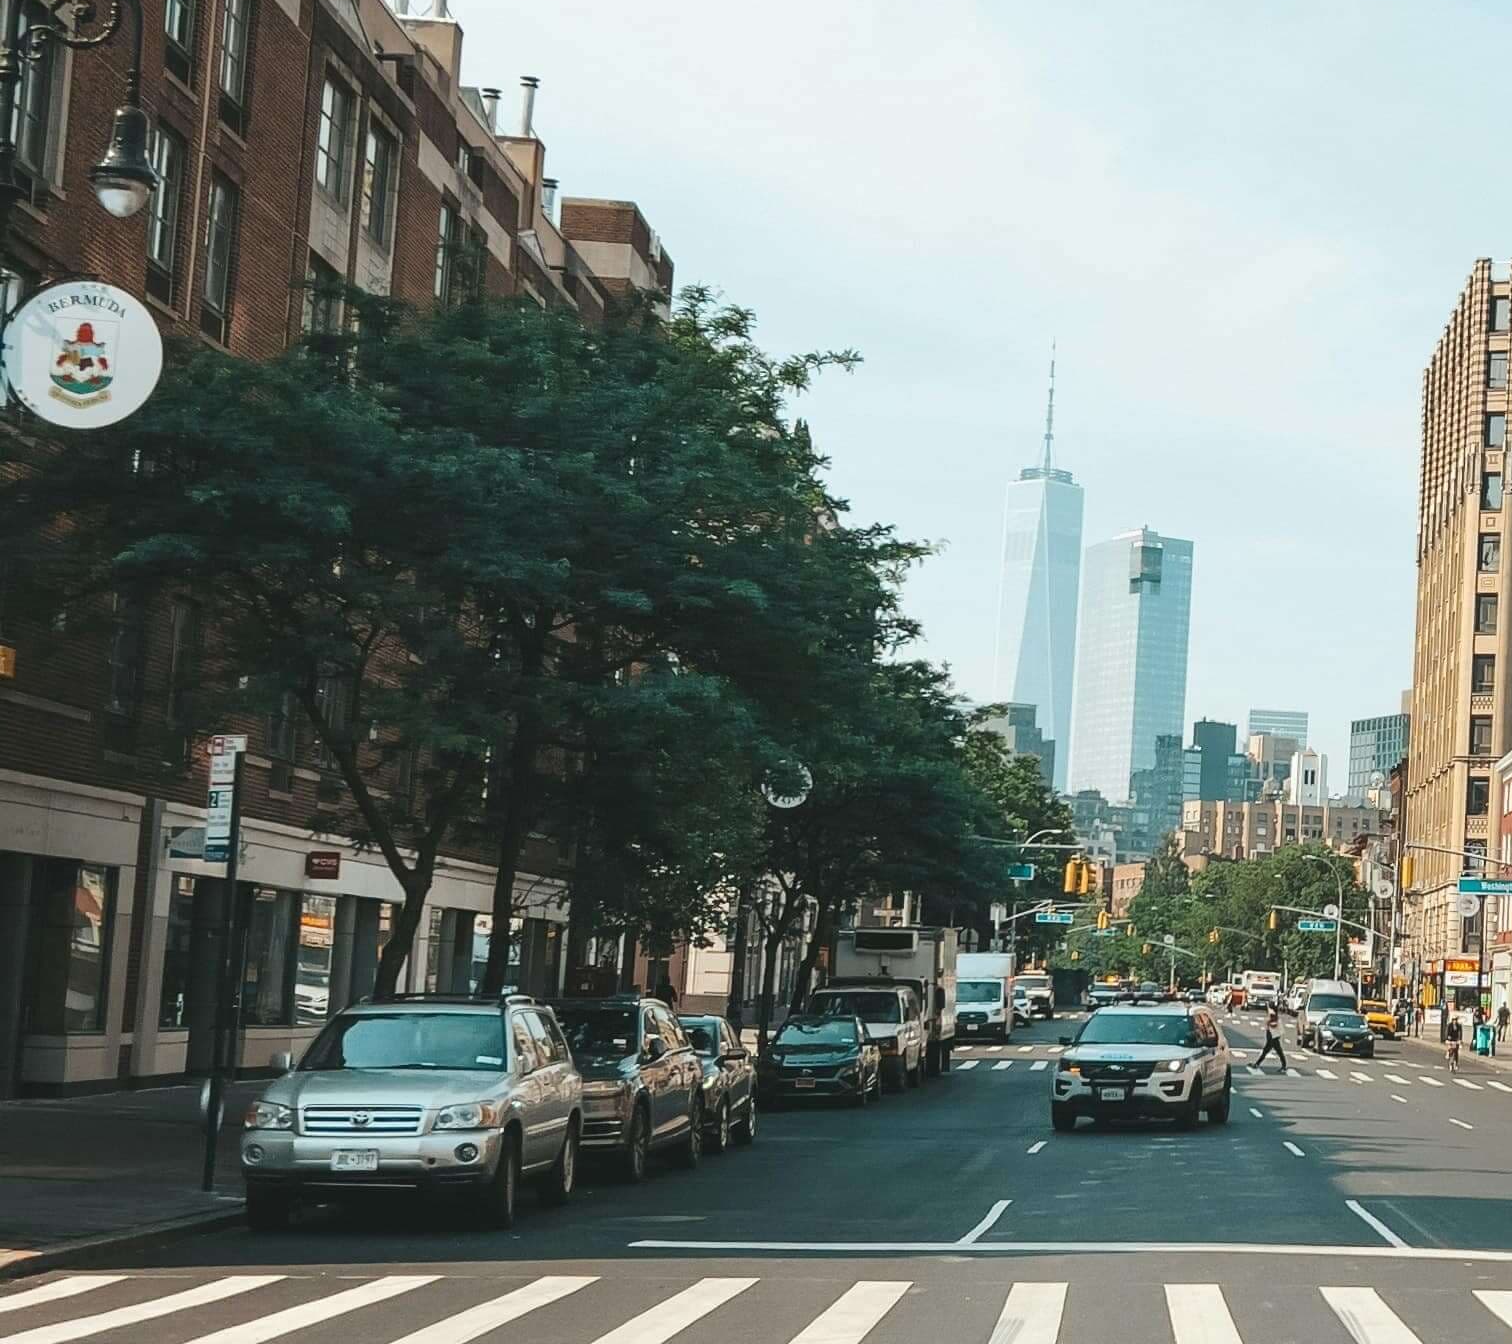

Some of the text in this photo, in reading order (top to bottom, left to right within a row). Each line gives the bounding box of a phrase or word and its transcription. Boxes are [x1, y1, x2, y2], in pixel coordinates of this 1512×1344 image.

[48, 293, 126, 319] BERMUDA
[210, 792, 217, 807] 2
[320, 857, 338, 866] CVS
